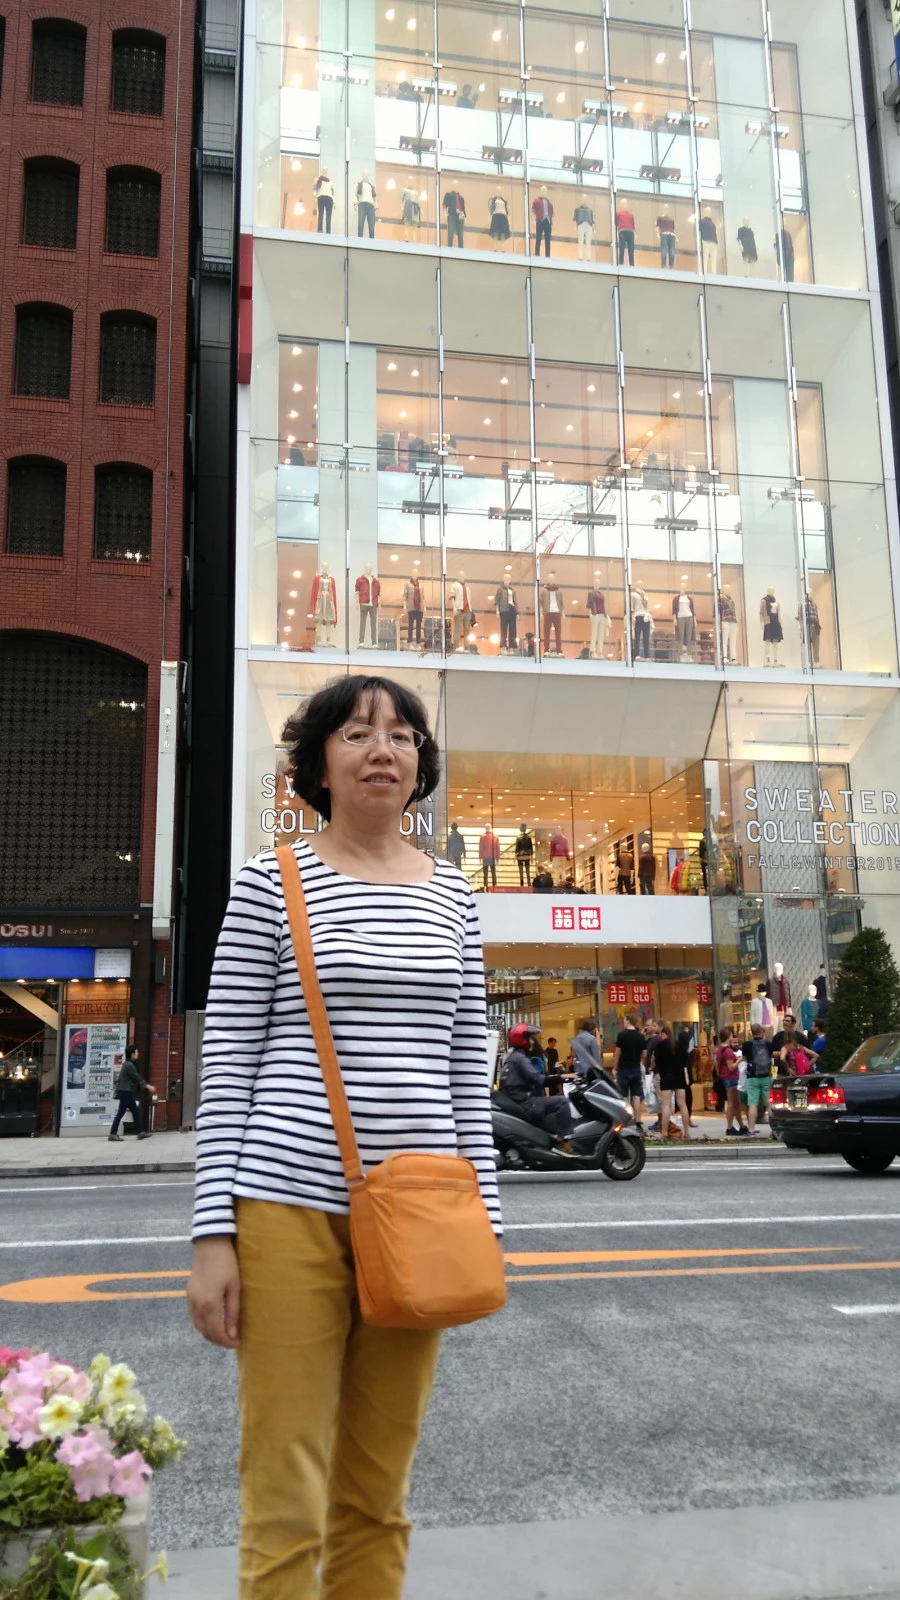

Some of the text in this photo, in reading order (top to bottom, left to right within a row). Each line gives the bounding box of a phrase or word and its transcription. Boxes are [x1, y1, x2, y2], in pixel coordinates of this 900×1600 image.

[744, 787, 898, 815] SWEATER
[260, 808, 434, 836] COLON
[746, 820, 900, 846] COLLECTION
[747, 855, 900, 871] FALL&WINTER2015
[554, 909, 572, 919] ユニ
[610, 985, 625, 993] ユニ
[633, 985, 648, 993] UNI
[633, 994, 650, 1003] QLO
[72, 1003, 120, 1015] TOBACCO
